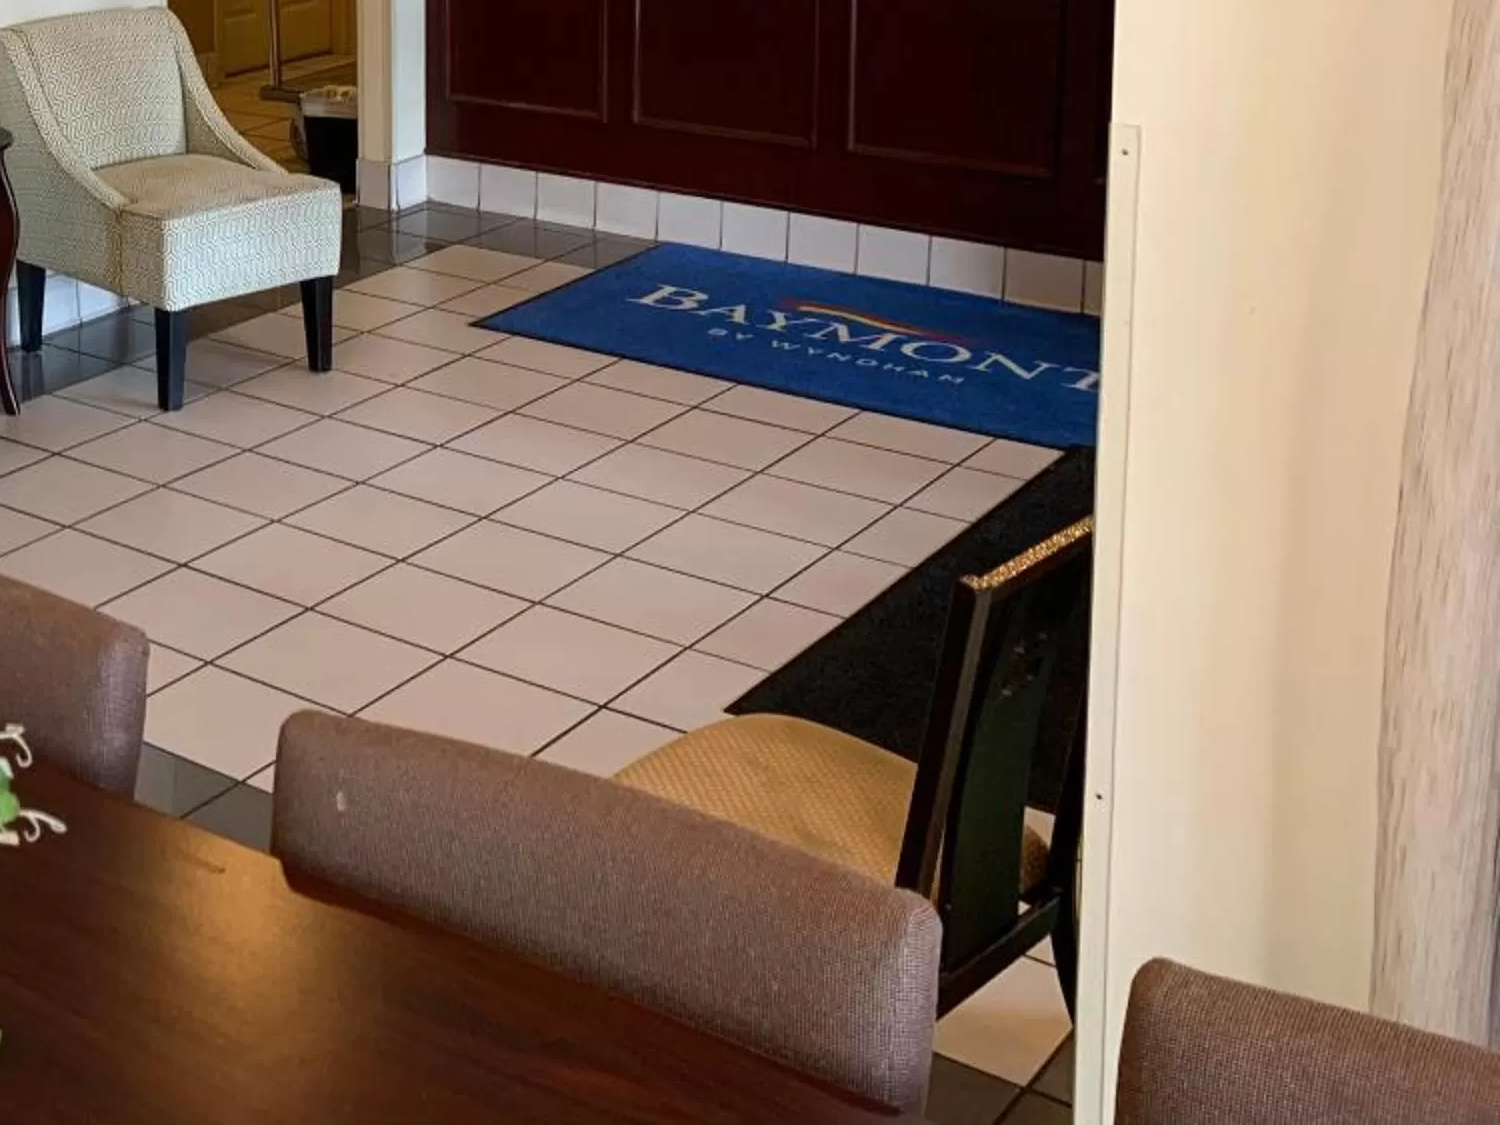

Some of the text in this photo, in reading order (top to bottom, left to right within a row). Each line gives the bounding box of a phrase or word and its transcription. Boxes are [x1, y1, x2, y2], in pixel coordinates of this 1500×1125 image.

[626, 283, 1100, 393] BAYMONT
[707, 327, 965, 385] BY WYNDHAM
